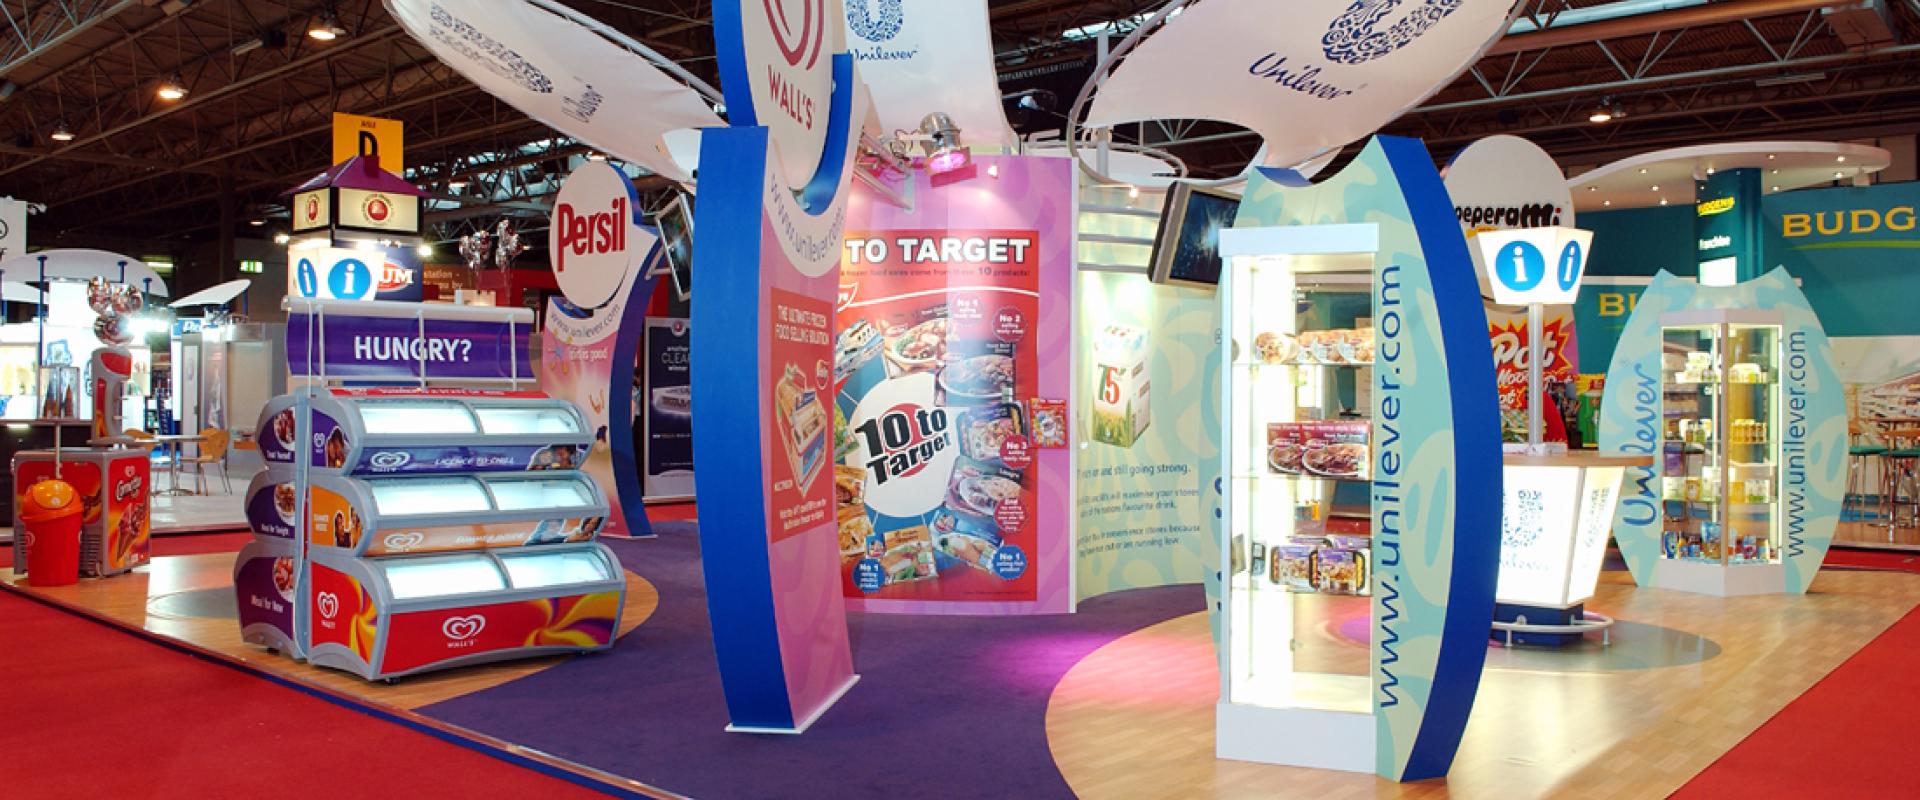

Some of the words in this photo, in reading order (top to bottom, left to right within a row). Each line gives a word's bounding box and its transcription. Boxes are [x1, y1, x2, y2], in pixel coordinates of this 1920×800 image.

[767, 64, 815, 132] WALL'S
[1249, 52, 1353, 100] Unilever
[359, 130, 378, 157] D
[557, 197, 626, 273] Persil
[1782, 206, 1917, 237] BUDG
[845, 238, 887, 264] TO
[897, 237, 1032, 264] TARGET
[978, 266, 993, 276] 10
[550, 304, 620, 340] www.unilever.com
[354, 336, 472, 362] HUNGRY?
[854, 411, 912, 462] 10
[916, 407, 947, 441] to
[865, 425, 950, 487] Target
[1624, 363, 1657, 527] Unlever
[1783, 331, 1806, 558] www.unilever.com
[1129, 465, 1155, 477] going
[1156, 464, 1191, 475] strong.
[1374, 265, 1401, 707] www.unilever.com
